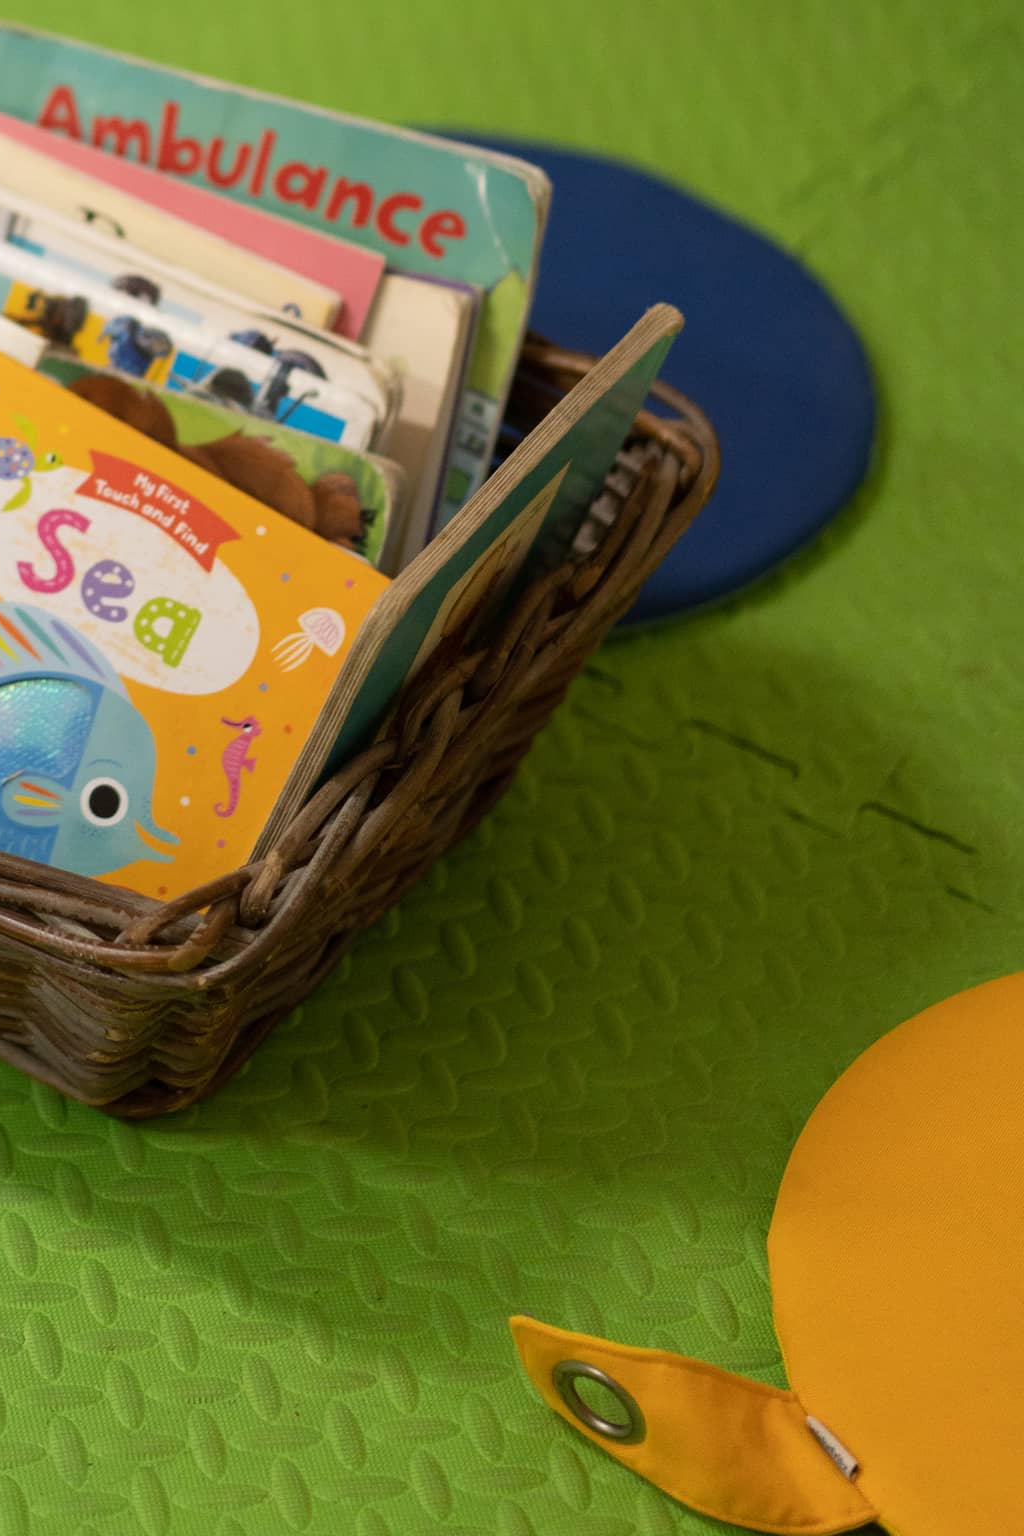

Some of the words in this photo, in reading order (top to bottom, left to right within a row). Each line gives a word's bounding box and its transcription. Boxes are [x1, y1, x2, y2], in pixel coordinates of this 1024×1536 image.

[35, 84, 468, 258] Ambulance
[95, 478, 140, 509] Touch
[141, 503, 175, 528] and
[174, 521, 209, 555] Find
[133, 473, 156, 497] My
[155, 484, 191, 515] First
[16, 508, 203, 668] Sea
